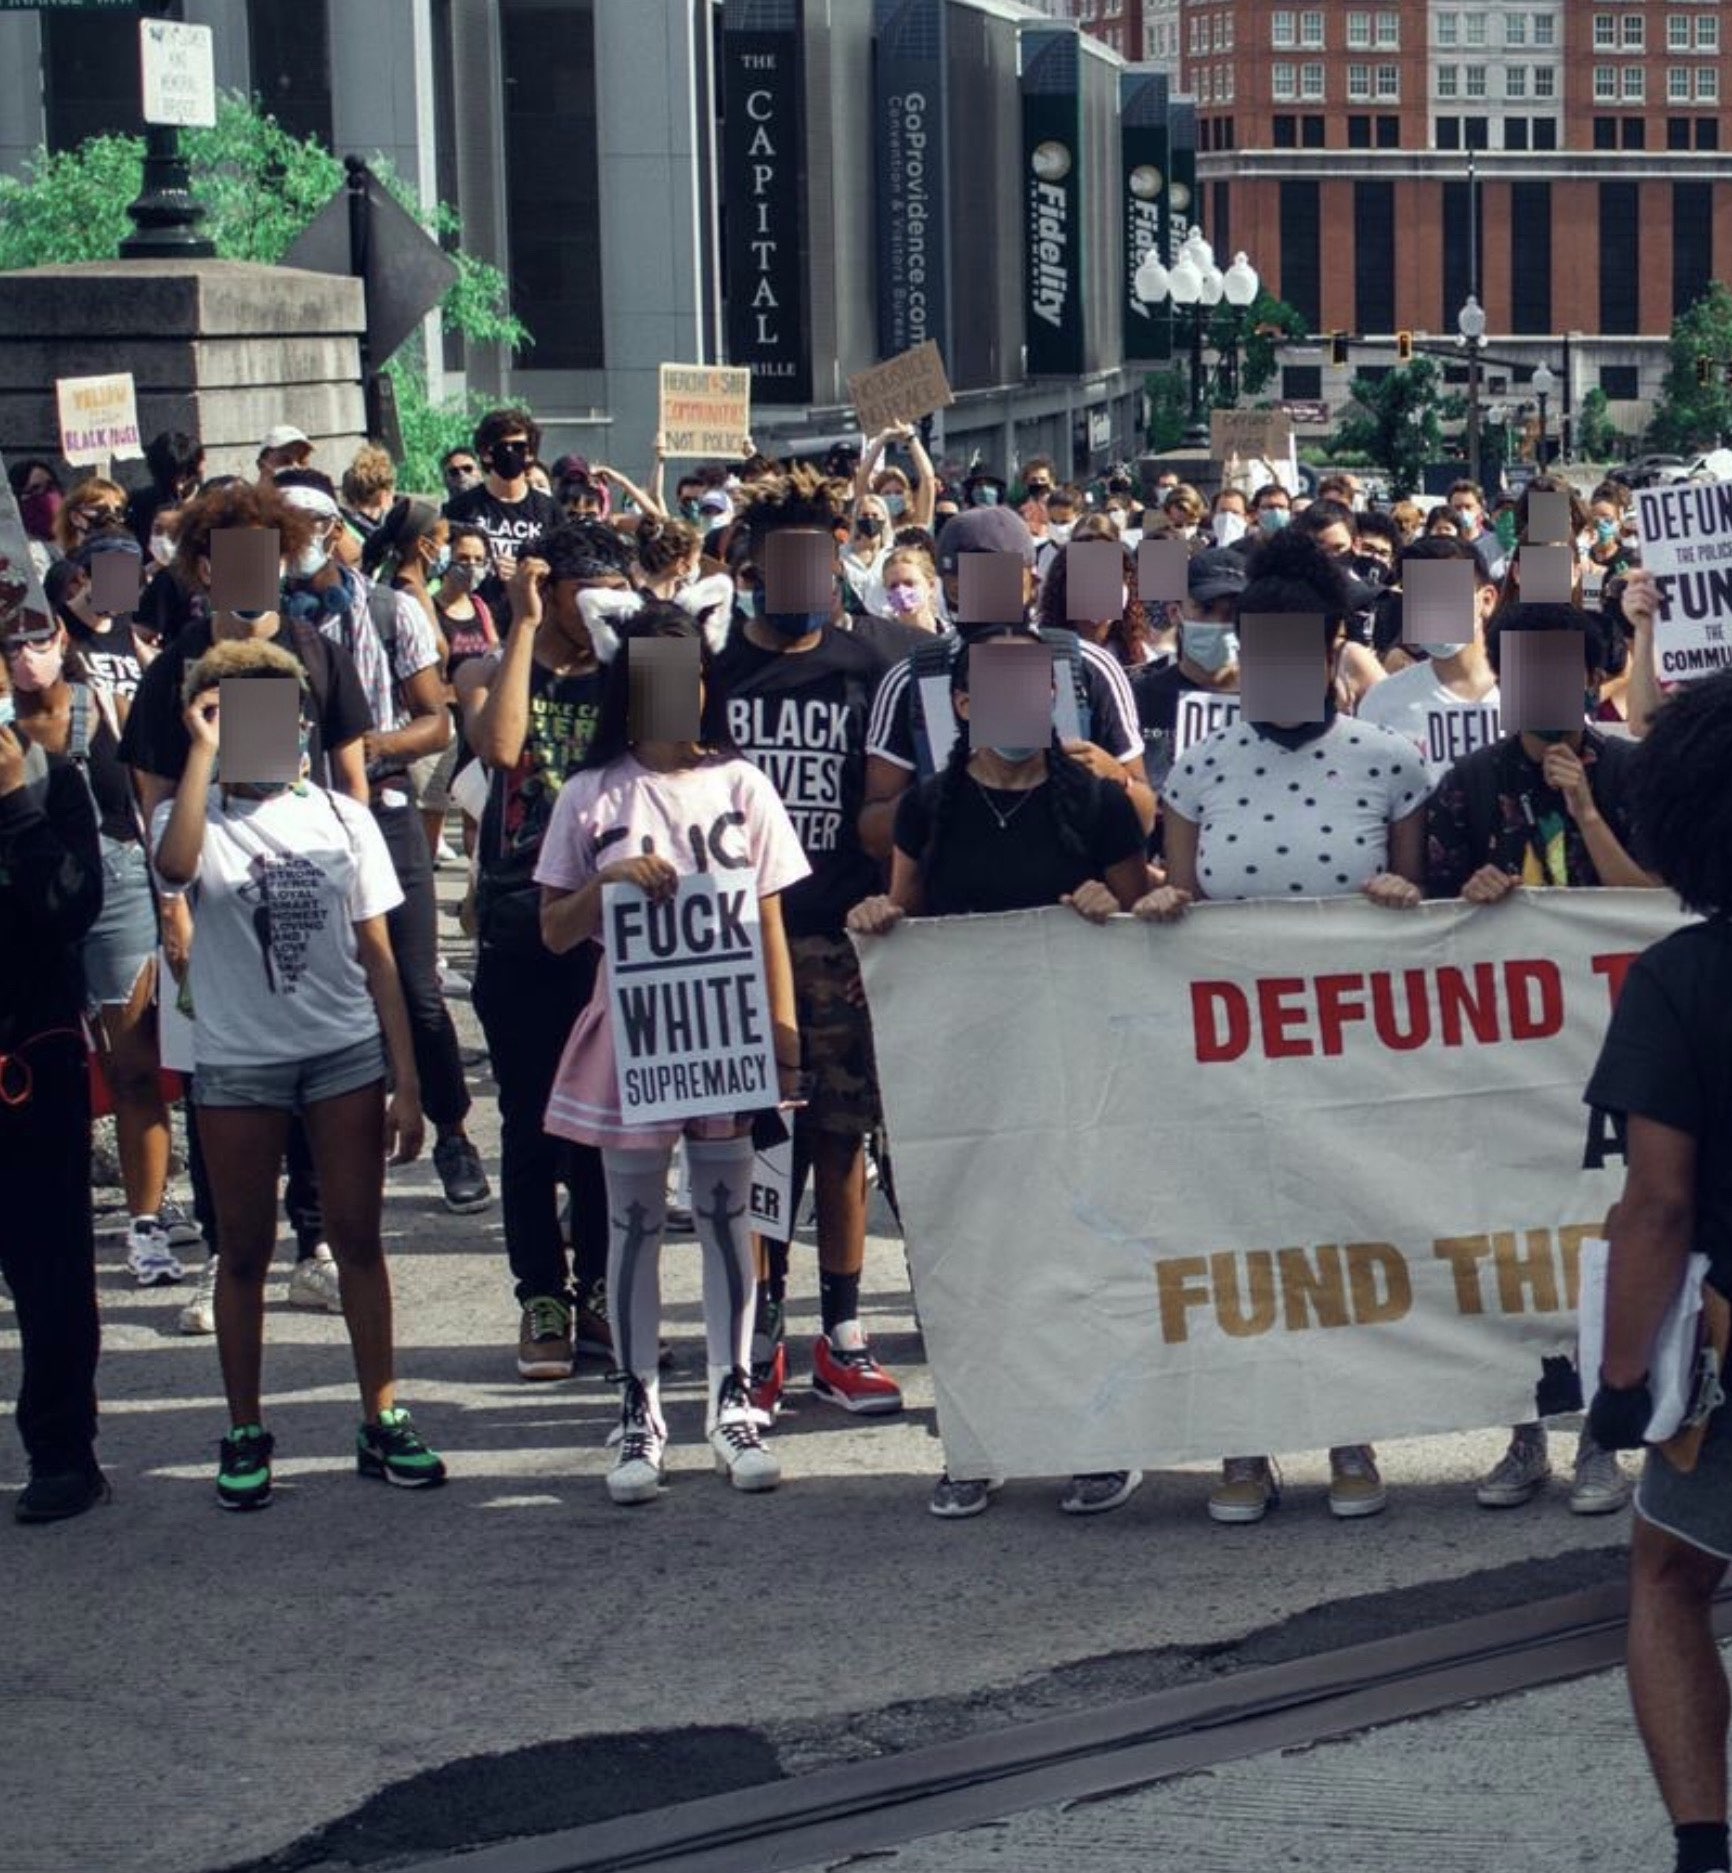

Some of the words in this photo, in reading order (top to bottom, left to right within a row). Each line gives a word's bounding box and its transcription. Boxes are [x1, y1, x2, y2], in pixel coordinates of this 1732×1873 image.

[741, 54, 777, 70] THE
[747, 90, 780, 344] CAPITAL
[904, 92, 929, 349] GoProvidence.com
[1033, 181, 1068, 328] Fidelity
[750, 362, 796, 376] RILLE
[665, 431, 693, 451] NOT
[1676, 547, 1696, 564] THE
[1705, 624, 1724, 641] THE
[727, 697, 850, 752] BLACK
[1184, 702, 1240, 750] DEF
[1427, 708, 1499, 763] DEFU
[755, 753, 839, 802] IVES
[790, 810, 841, 851] TER
[613, 889, 752, 961] FUCK
[617, 973, 763, 1058] WHITE
[1189, 959, 1565, 1064] DEFUND
[625, 1054, 768, 1107] SUPREMACY
[1155, 1241, 1413, 1345] FUND
